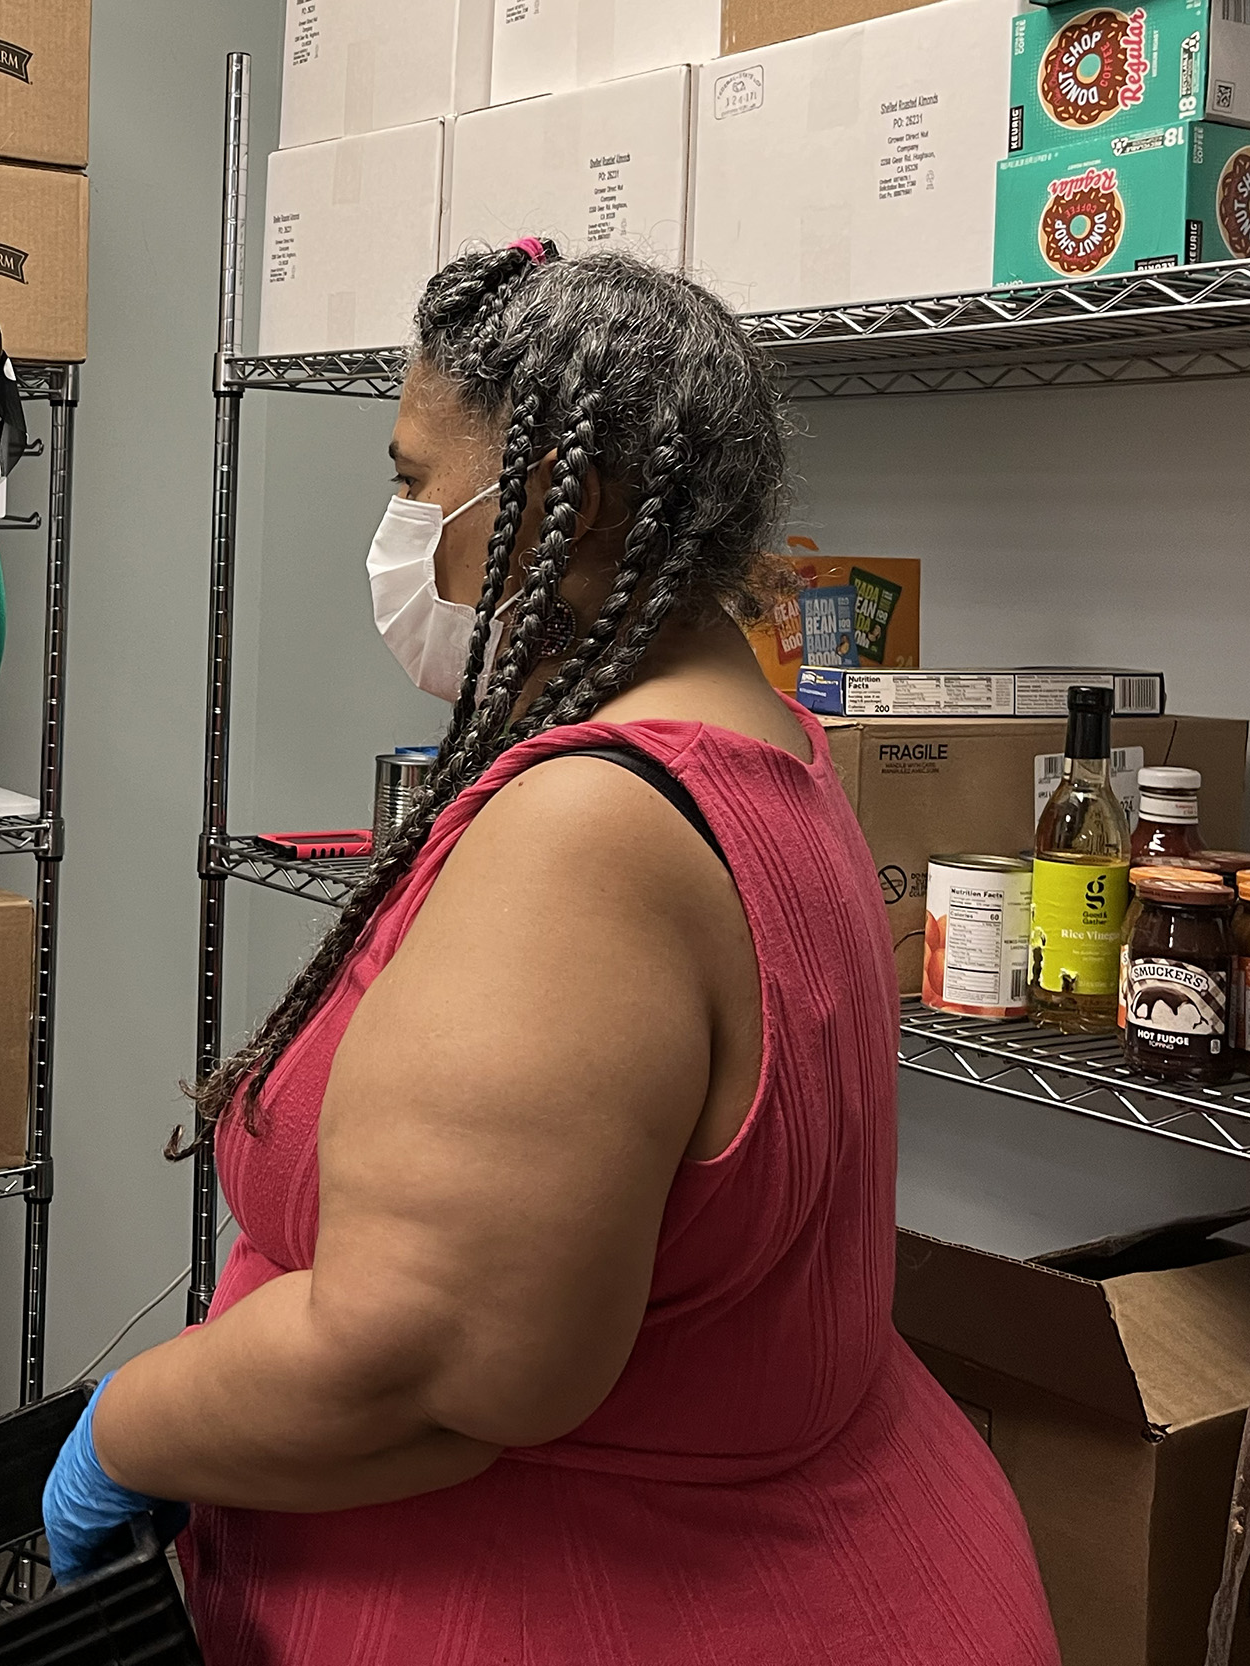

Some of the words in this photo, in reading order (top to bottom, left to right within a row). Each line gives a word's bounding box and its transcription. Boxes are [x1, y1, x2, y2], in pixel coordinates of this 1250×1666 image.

[1018, 19, 1026, 55] COFFEE
[1062, 30, 1103, 68] SHOP
[1118, 8, 1147, 109] Regular
[1100, 42, 1114, 88] COFFEE
[1058, 71, 1099, 106] DONUT
[898, 97, 917, 111] Roasted
[918, 93, 938, 107] Almonds
[1178, 95, 1197, 120] 18
[1010, 108, 1020, 150] KEURIG
[1164, 126, 1185, 147] 18
[1048, 169, 1117, 200] Regular
[1065, 203, 1097, 217] COFFEE
[1054, 218, 1077, 255] SHOP
[1077, 212, 1108, 257] DONUT
[805, 599, 837, 615] BADA
[854, 596, 877, 619] EAN
[805, 615, 837, 635] BEAN
[782, 632, 803, 653] BOO
[806, 633, 837, 653] BADA
[807, 650, 843, 666] BOOM
[848, 675, 881, 683] Nutrition
[874, 704, 890, 713] 200
[879, 743, 949, 761] FRAGILE
[951, 888, 981, 898] Nutrition
[950, 911, 974, 919] Calories
[1082, 918, 1107, 926] Gather
[1061, 929, 1085, 940] Rice
[1133, 965, 1203, 989] SMUCKER'S
[1137, 1029, 1155, 1041] HOT
[1157, 1033, 1190, 1046] FUDGE
